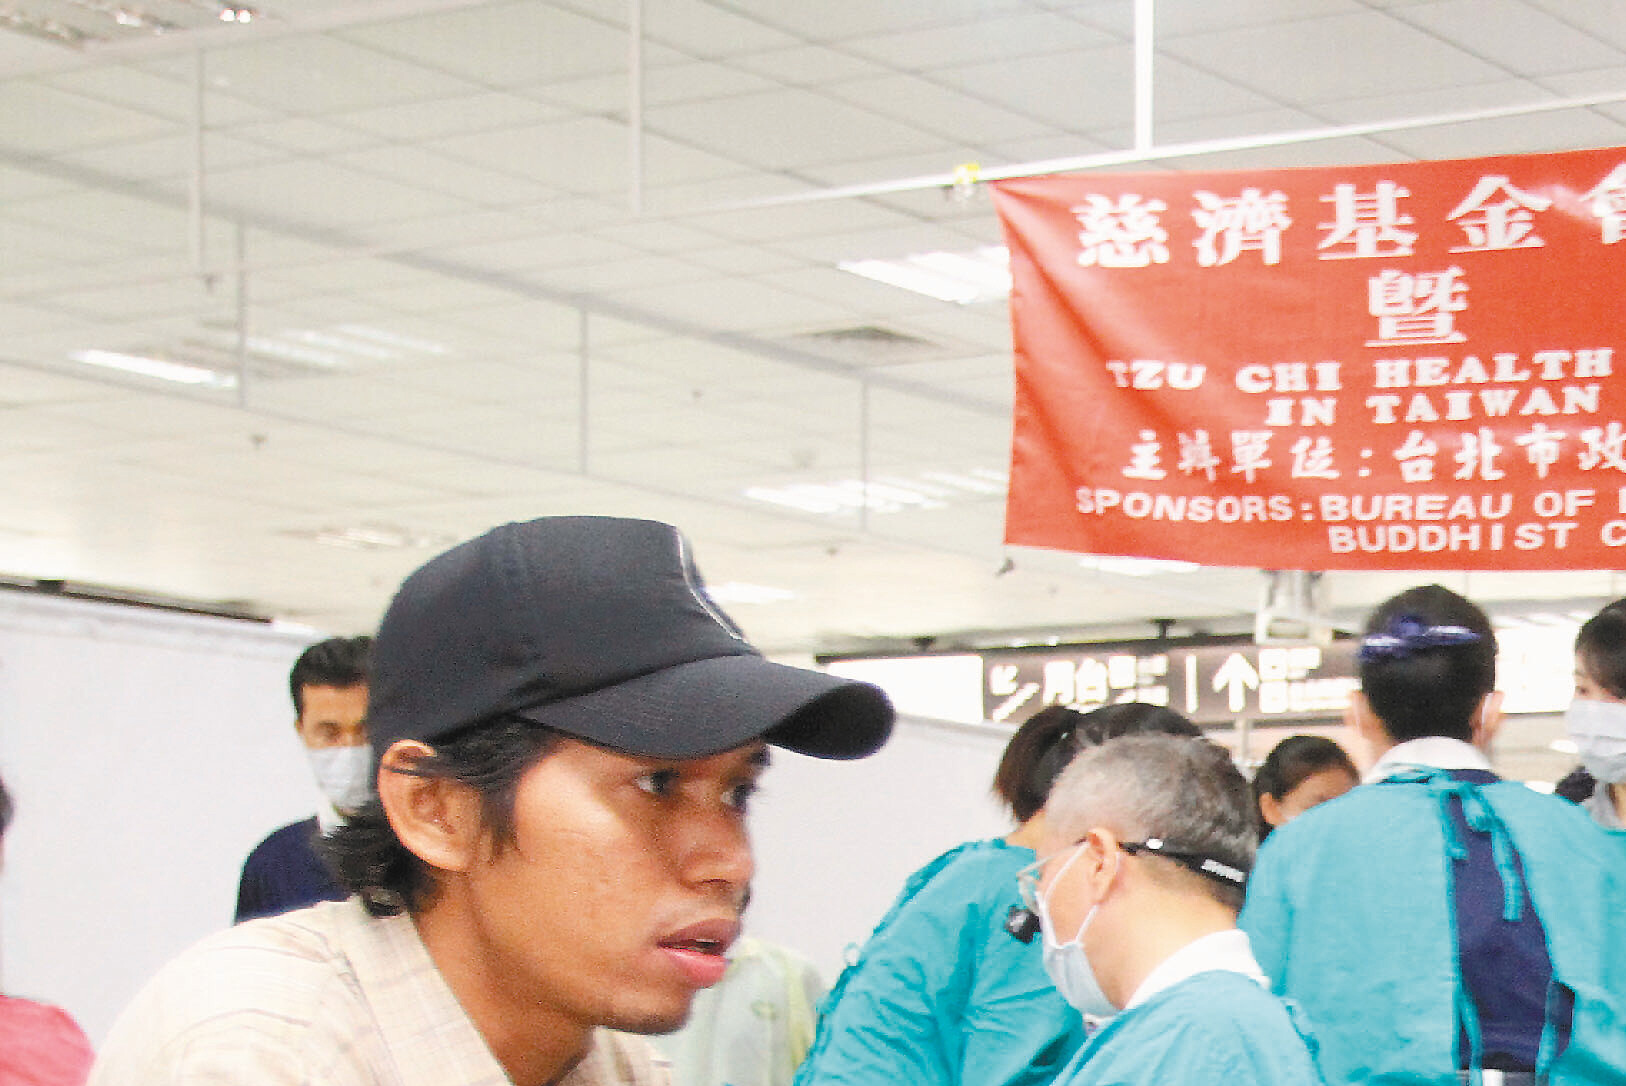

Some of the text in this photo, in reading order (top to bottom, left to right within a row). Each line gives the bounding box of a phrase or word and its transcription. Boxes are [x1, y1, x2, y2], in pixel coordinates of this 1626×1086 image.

[1366, 266, 1469, 348] 暨
[1107, 358, 1207, 390] TZU
[1235, 361, 1341, 393] CHI
[1373, 348, 1612, 388] HEALTH
[1264, 396, 1337, 427] IN
[1366, 384, 1600, 424] TAIWAN
[1533, 490, 1596, 517] OF
[1328, 523, 1579, 553] BUDDHIST
